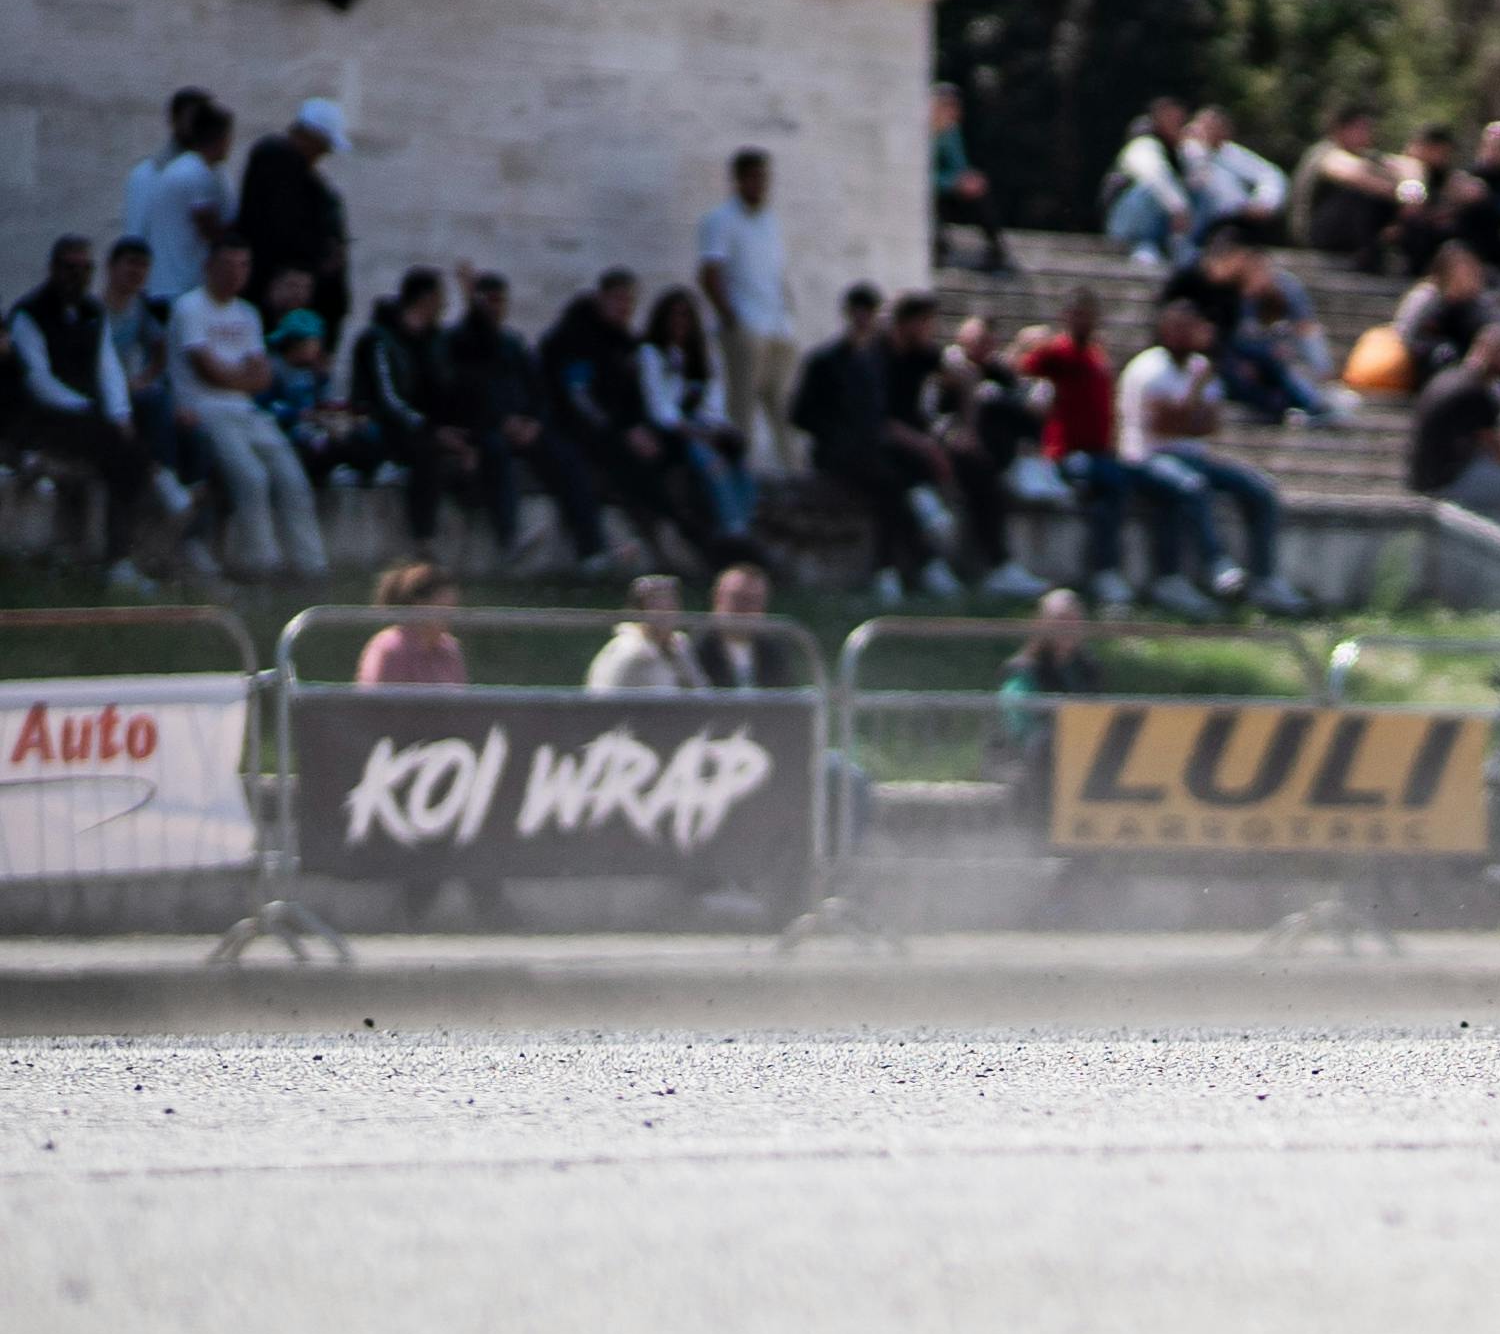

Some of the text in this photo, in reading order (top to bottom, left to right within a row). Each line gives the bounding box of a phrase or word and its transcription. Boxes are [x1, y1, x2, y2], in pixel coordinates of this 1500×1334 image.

[10, 700, 158, 764] Auto
[1080, 707, 1467, 810] LULI
[344, 721, 774, 854] KOI WRAP
